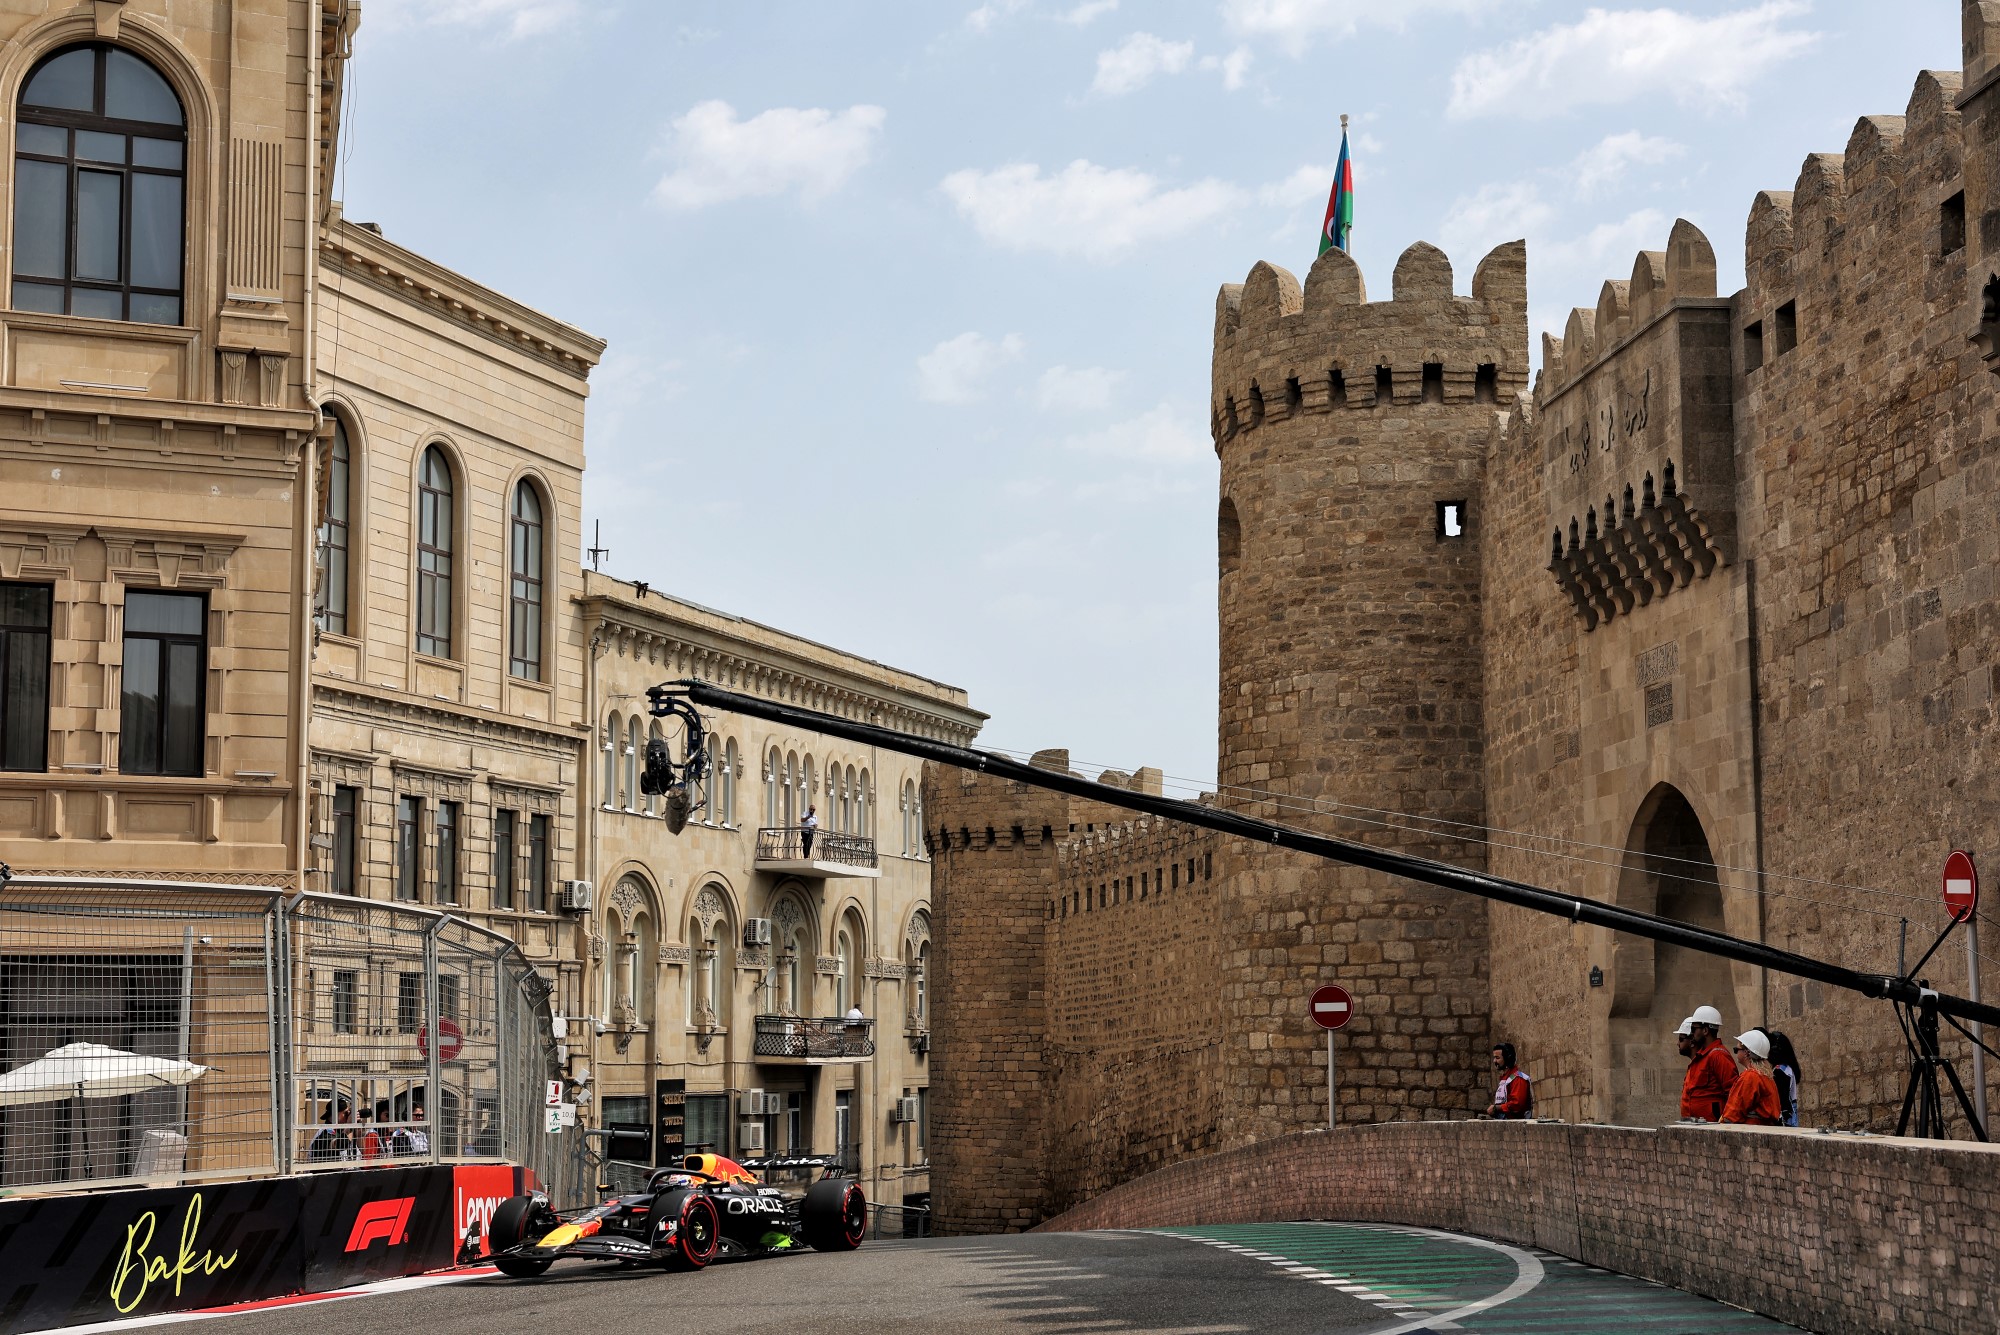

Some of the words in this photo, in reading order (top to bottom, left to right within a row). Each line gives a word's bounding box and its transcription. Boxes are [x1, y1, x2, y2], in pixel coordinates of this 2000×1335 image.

[663, 1116, 684, 1126] SWEET
[756, 1187, 780, 1196] HONDA
[458, 1186, 507, 1240] Leno
[727, 1197, 785, 1215] ORACLE
[344, 1196, 416, 1253] F1
[658, 1220, 678, 1231] Mobil
[110, 1192, 238, 1314] Baku
